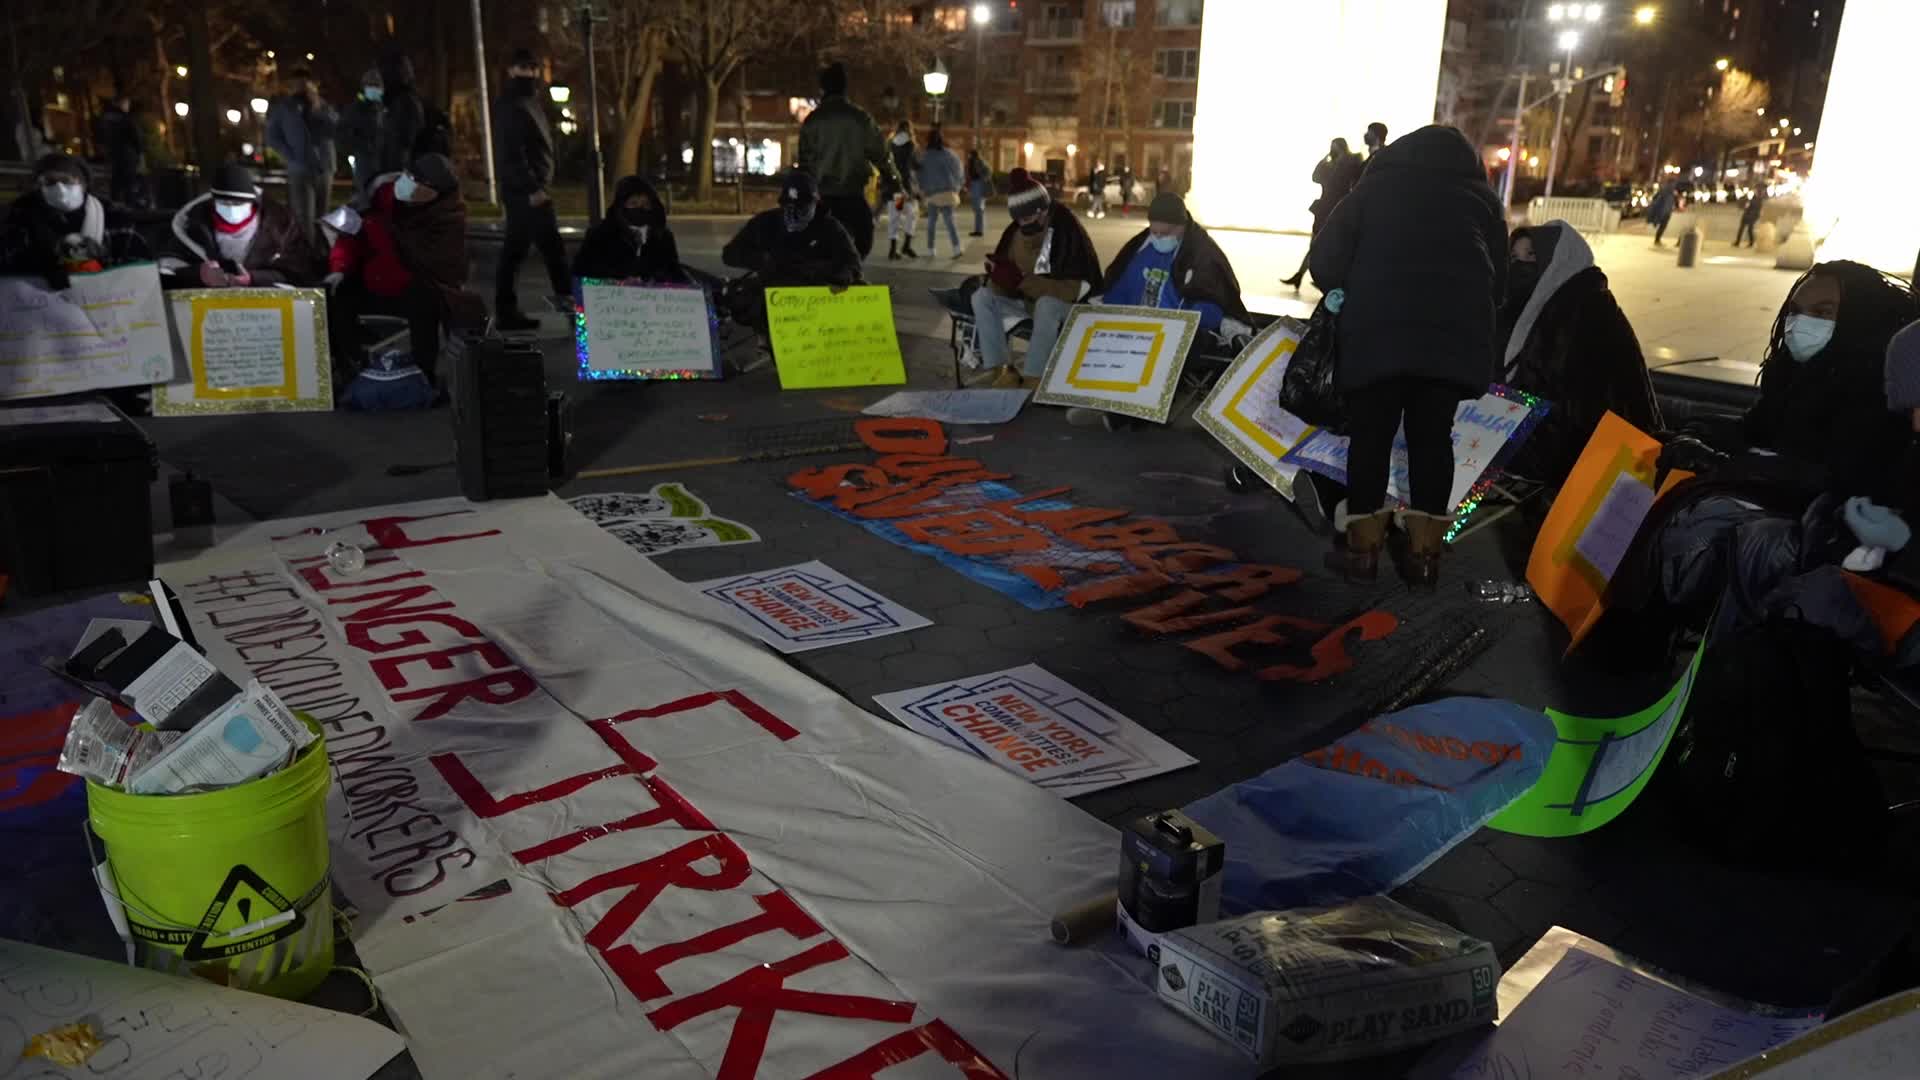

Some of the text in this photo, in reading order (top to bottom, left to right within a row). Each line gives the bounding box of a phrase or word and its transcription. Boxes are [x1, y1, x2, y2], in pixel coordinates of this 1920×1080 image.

[271, 510, 537, 720] HUNGER
[735, 588, 820, 632] CHANGE
[777, 582, 859, 623] NEW YORK
[943, 704, 1058, 772] CHANGE
[991, 693, 1104, 758] NEW YORK
[225, 934, 276, 957] ATTENTION
[1196, 980, 1230, 1011] PLAY
[1473, 966, 1491, 990] 50
[1192, 995, 1232, 1032] SAND
[1239, 995, 1256, 1018] 50
[1328, 1012, 1395, 1043] PLAY
[1401, 999, 1470, 1032] SAND
